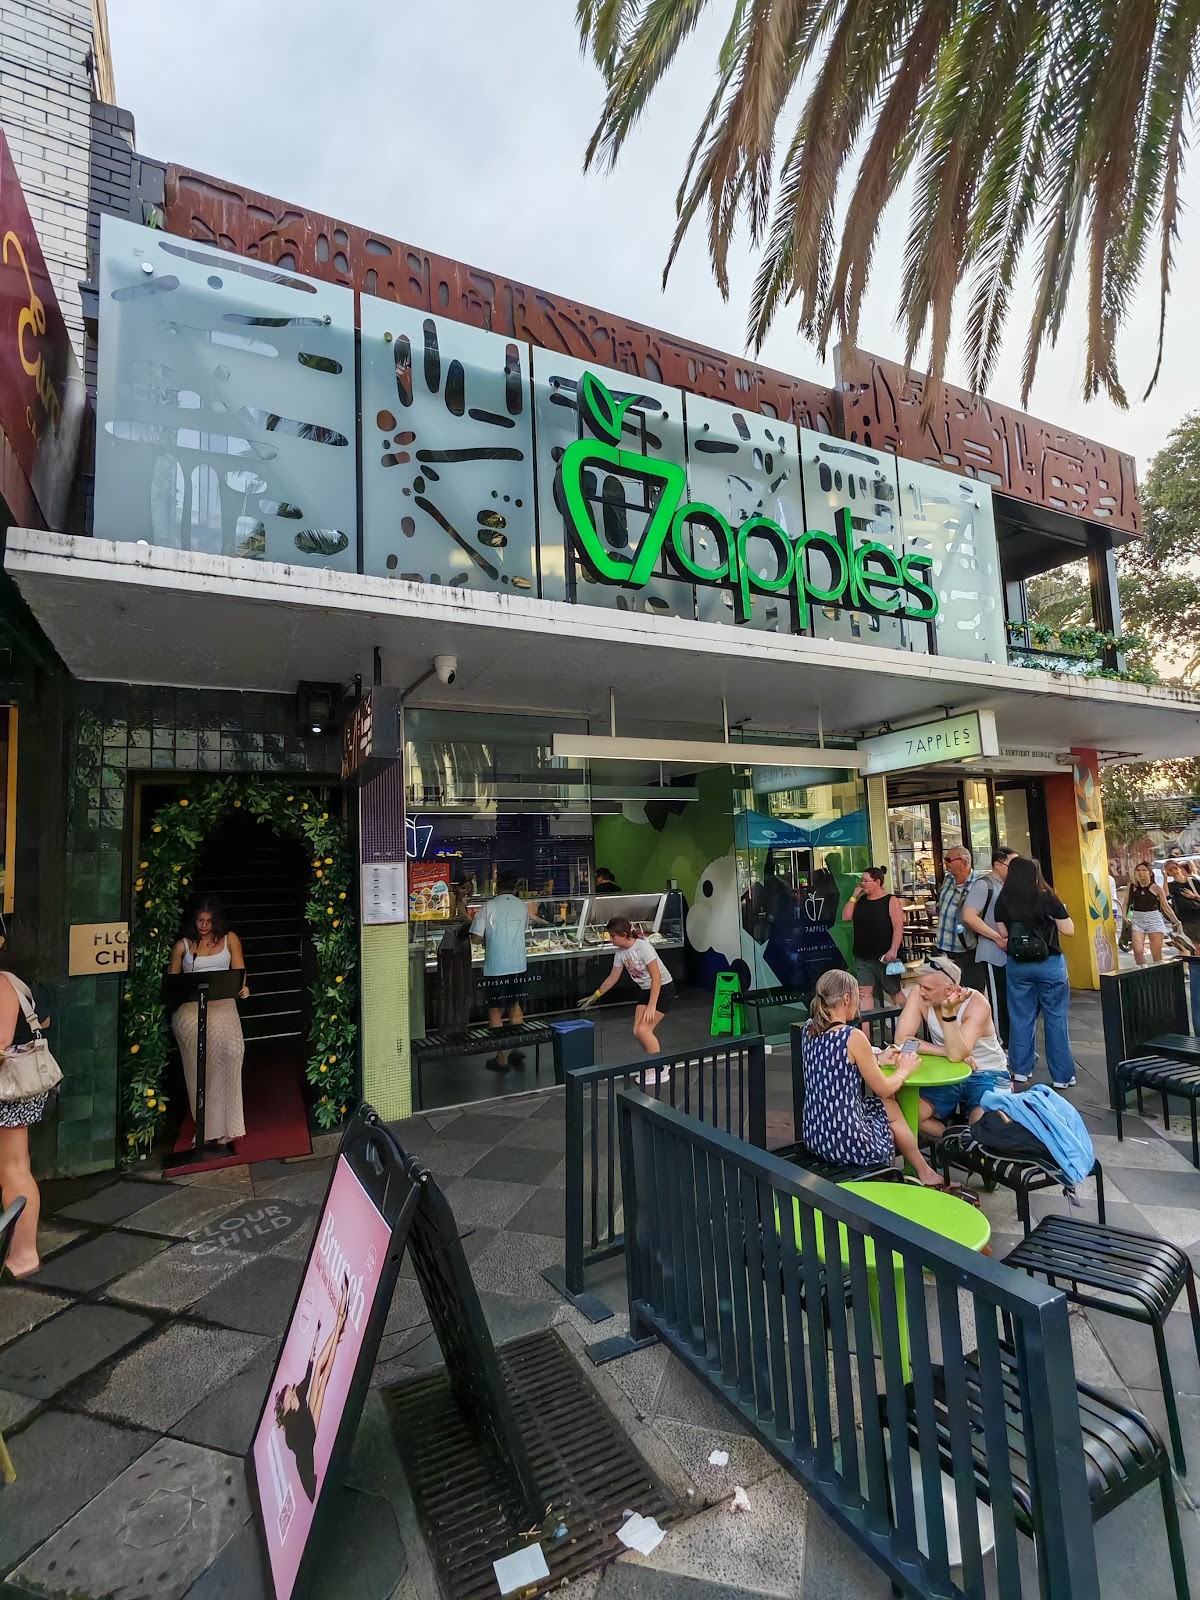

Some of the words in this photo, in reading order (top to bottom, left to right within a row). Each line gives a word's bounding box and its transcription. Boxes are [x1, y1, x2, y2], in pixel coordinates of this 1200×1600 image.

[905, 728, 971, 756] 7APPLES
[477, 979, 510, 988] ARTISAN
[513, 975, 542, 984] GELATO
[191, 1216, 293, 1255] CHILD
